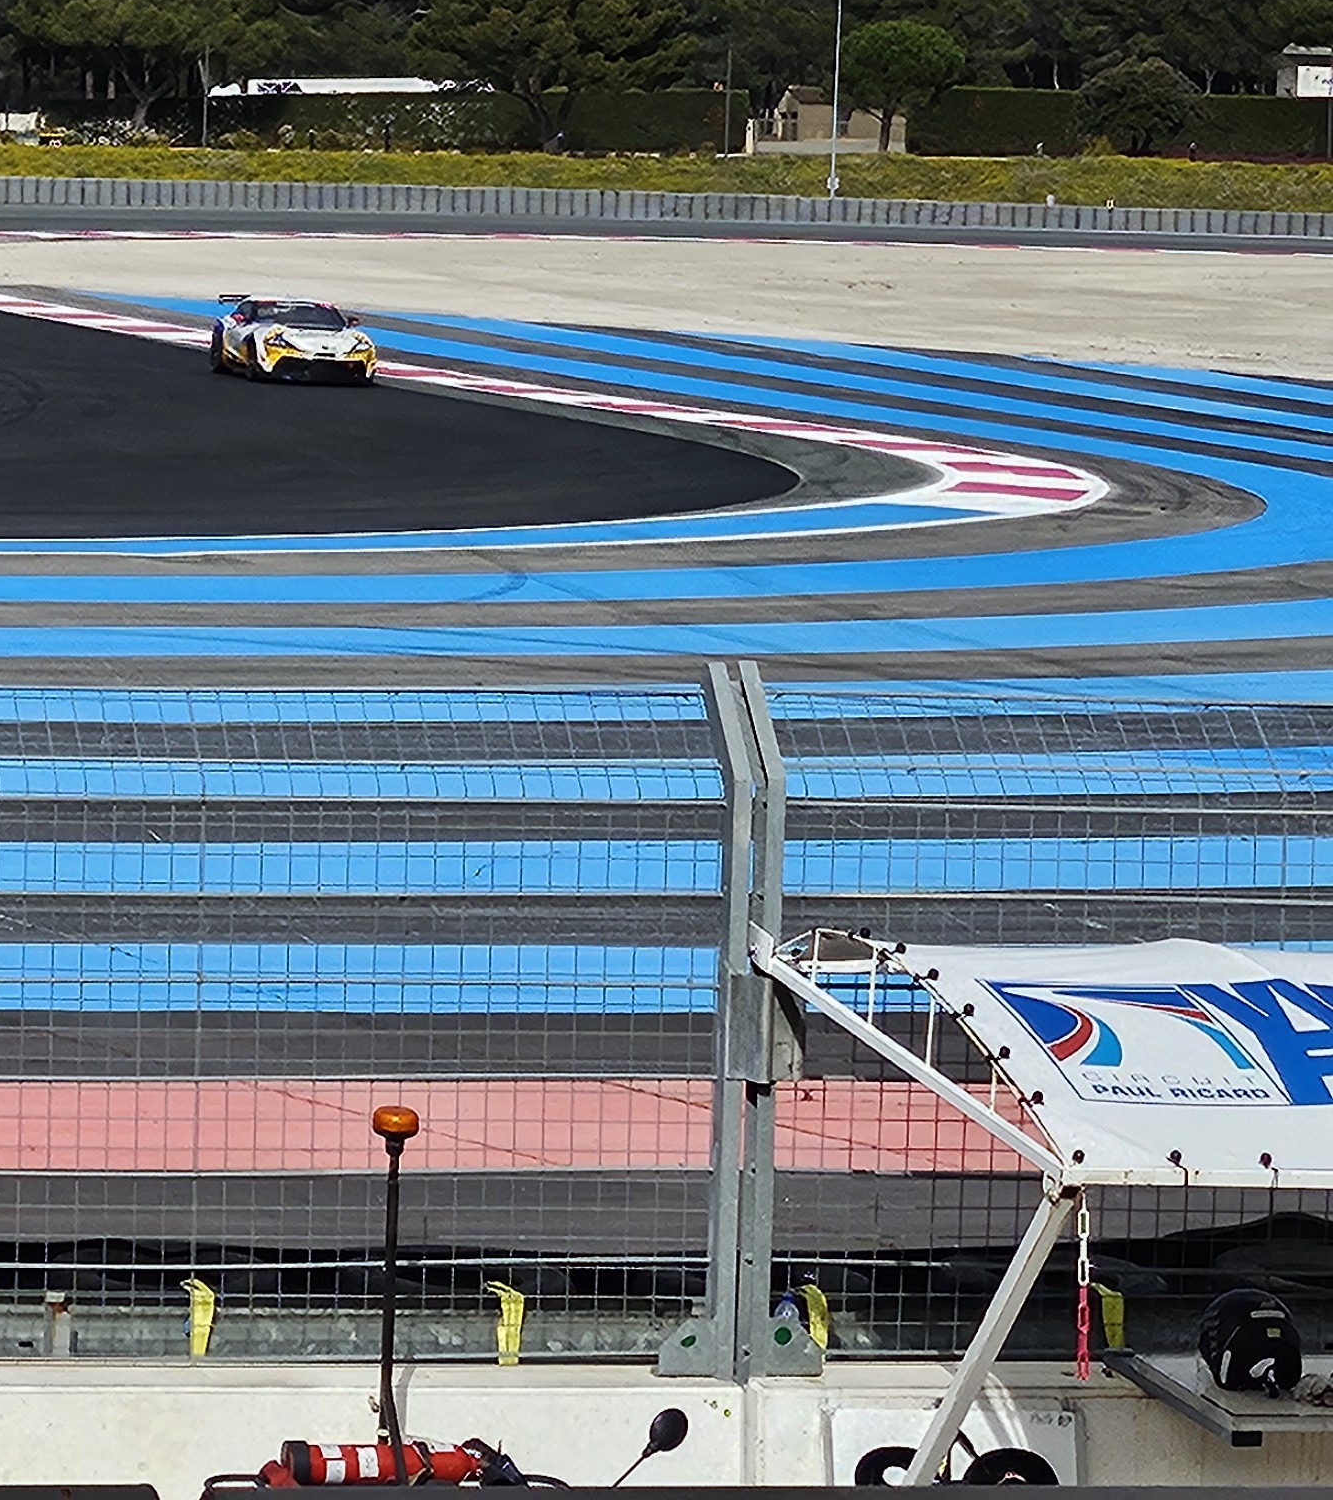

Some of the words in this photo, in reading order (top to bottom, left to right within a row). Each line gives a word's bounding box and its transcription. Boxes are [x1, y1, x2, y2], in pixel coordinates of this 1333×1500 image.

[1082, 1070, 1257, 1086] CIRCUIT
[1091, 1083, 1162, 1099] PAUL
[1168, 1087, 1271, 1100] RICARD
